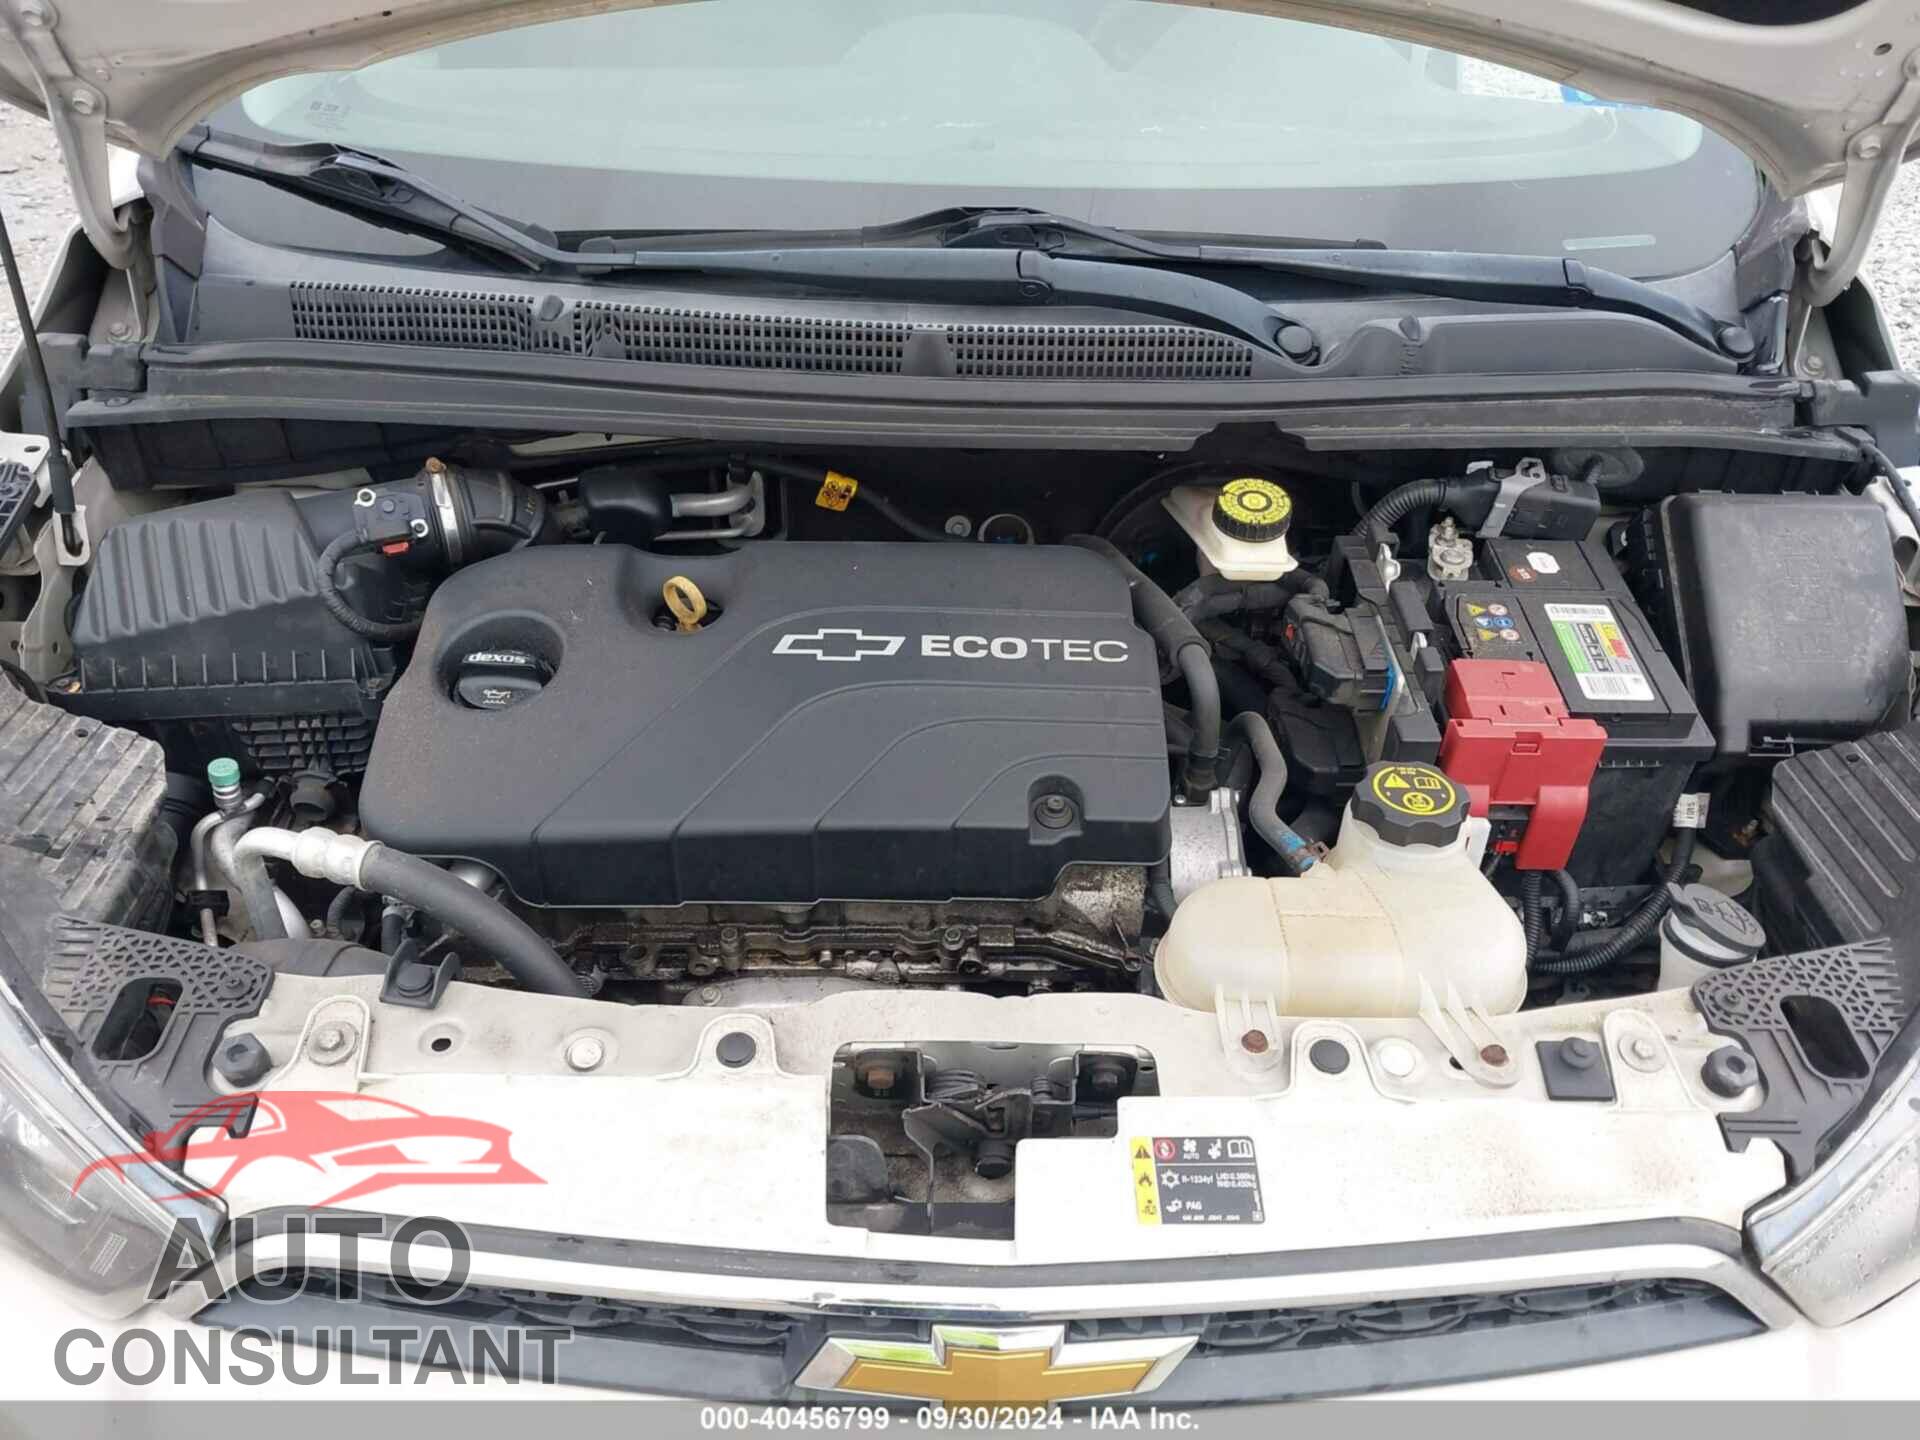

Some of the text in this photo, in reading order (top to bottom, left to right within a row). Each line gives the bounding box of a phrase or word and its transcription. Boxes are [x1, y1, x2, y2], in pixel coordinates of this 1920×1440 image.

[921, 634, 1128, 663] ECOTEC
[468, 652, 526, 664] dexos
[1183, 1152, 1200, 1160] AUTO
[1185, 1200, 1202, 1210] PAG
